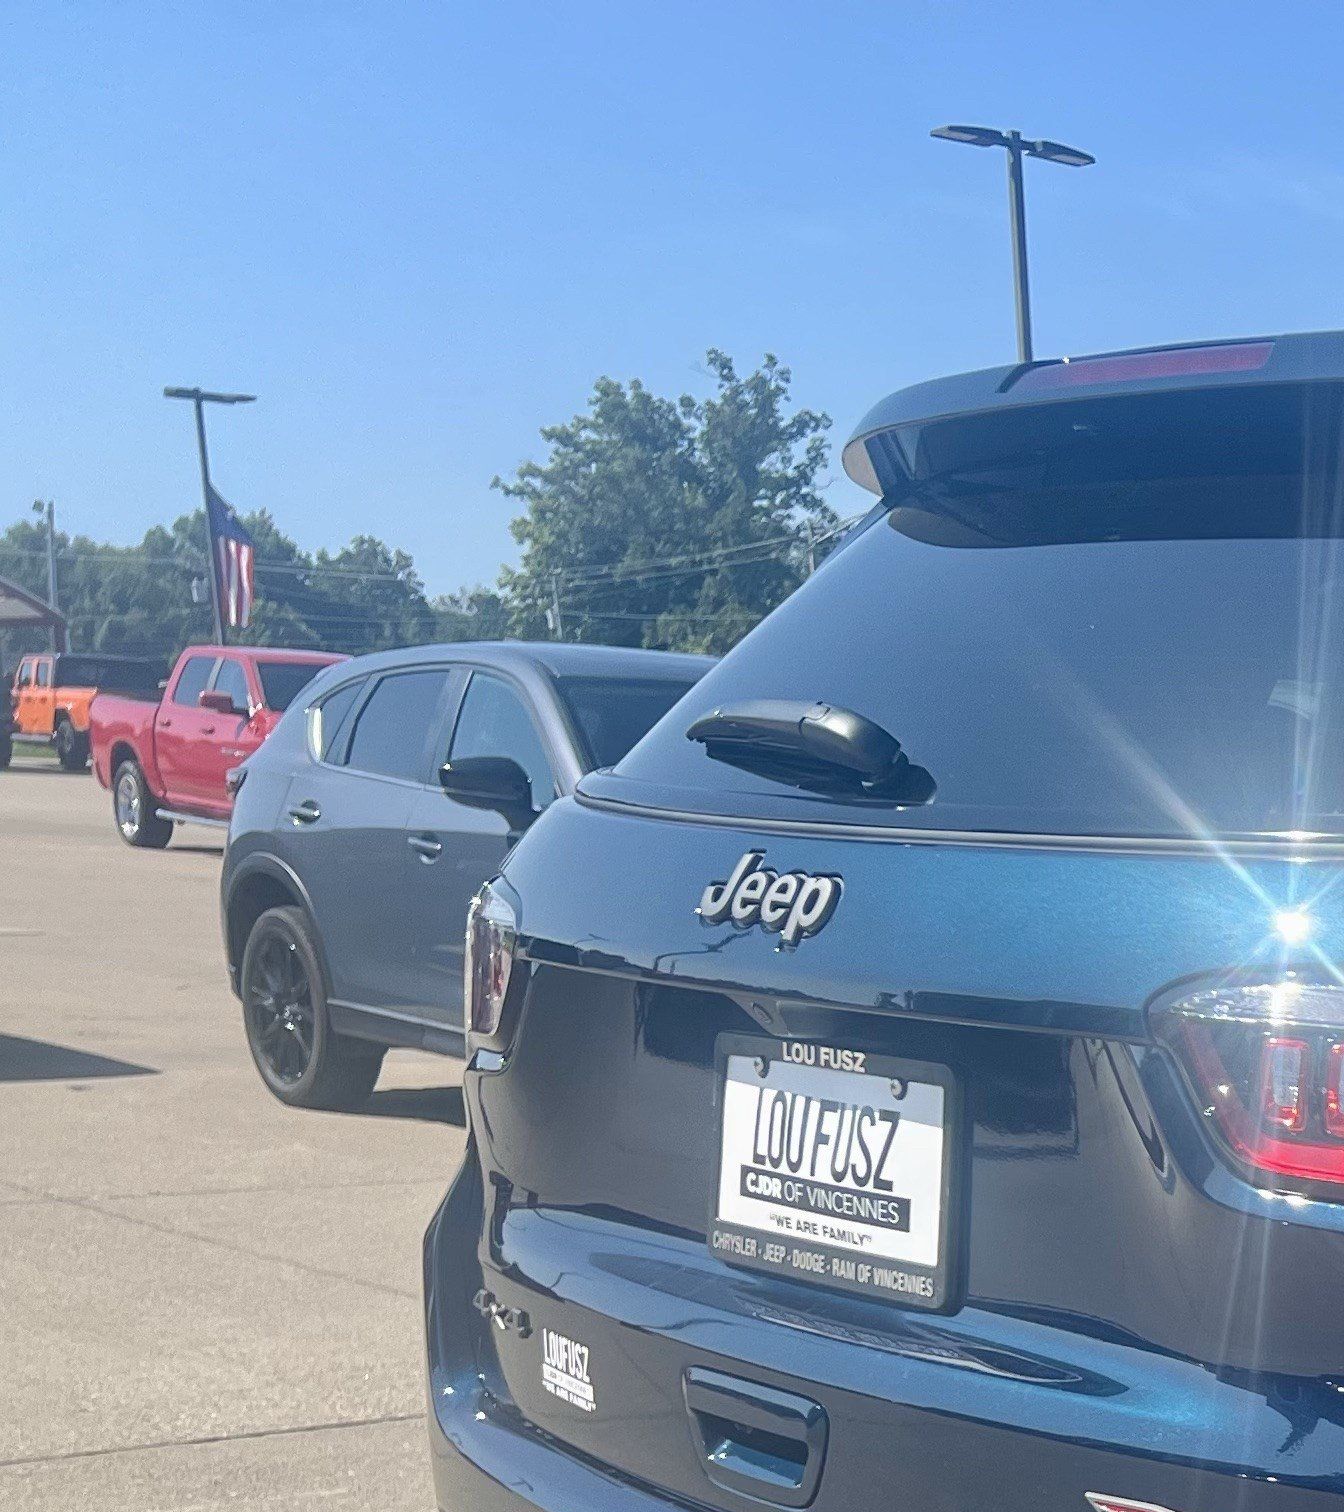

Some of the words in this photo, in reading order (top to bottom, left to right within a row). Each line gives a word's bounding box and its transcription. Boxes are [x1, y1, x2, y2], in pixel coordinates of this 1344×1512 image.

[699, 849, 838, 949] Jeep
[782, 1041, 815, 1066] LOU
[819, 1046, 867, 1074] FUSZ
[745, 1171, 783, 1200] CJDR
[784, 1182, 804, 1204] OF
[806, 1184, 900, 1225] VINCENNES
[796, 1219, 820, 1237] ARE
[712, 1230, 758, 1259] CHRYSLER
[762, 1242, 787, 1265] JEEP
[793, 1249, 826, 1275] DODGE
[832, 1257, 857, 1282] RAM
[857, 1264, 873, 1284] OF
[873, 1268, 935, 1298] VINCENNES
